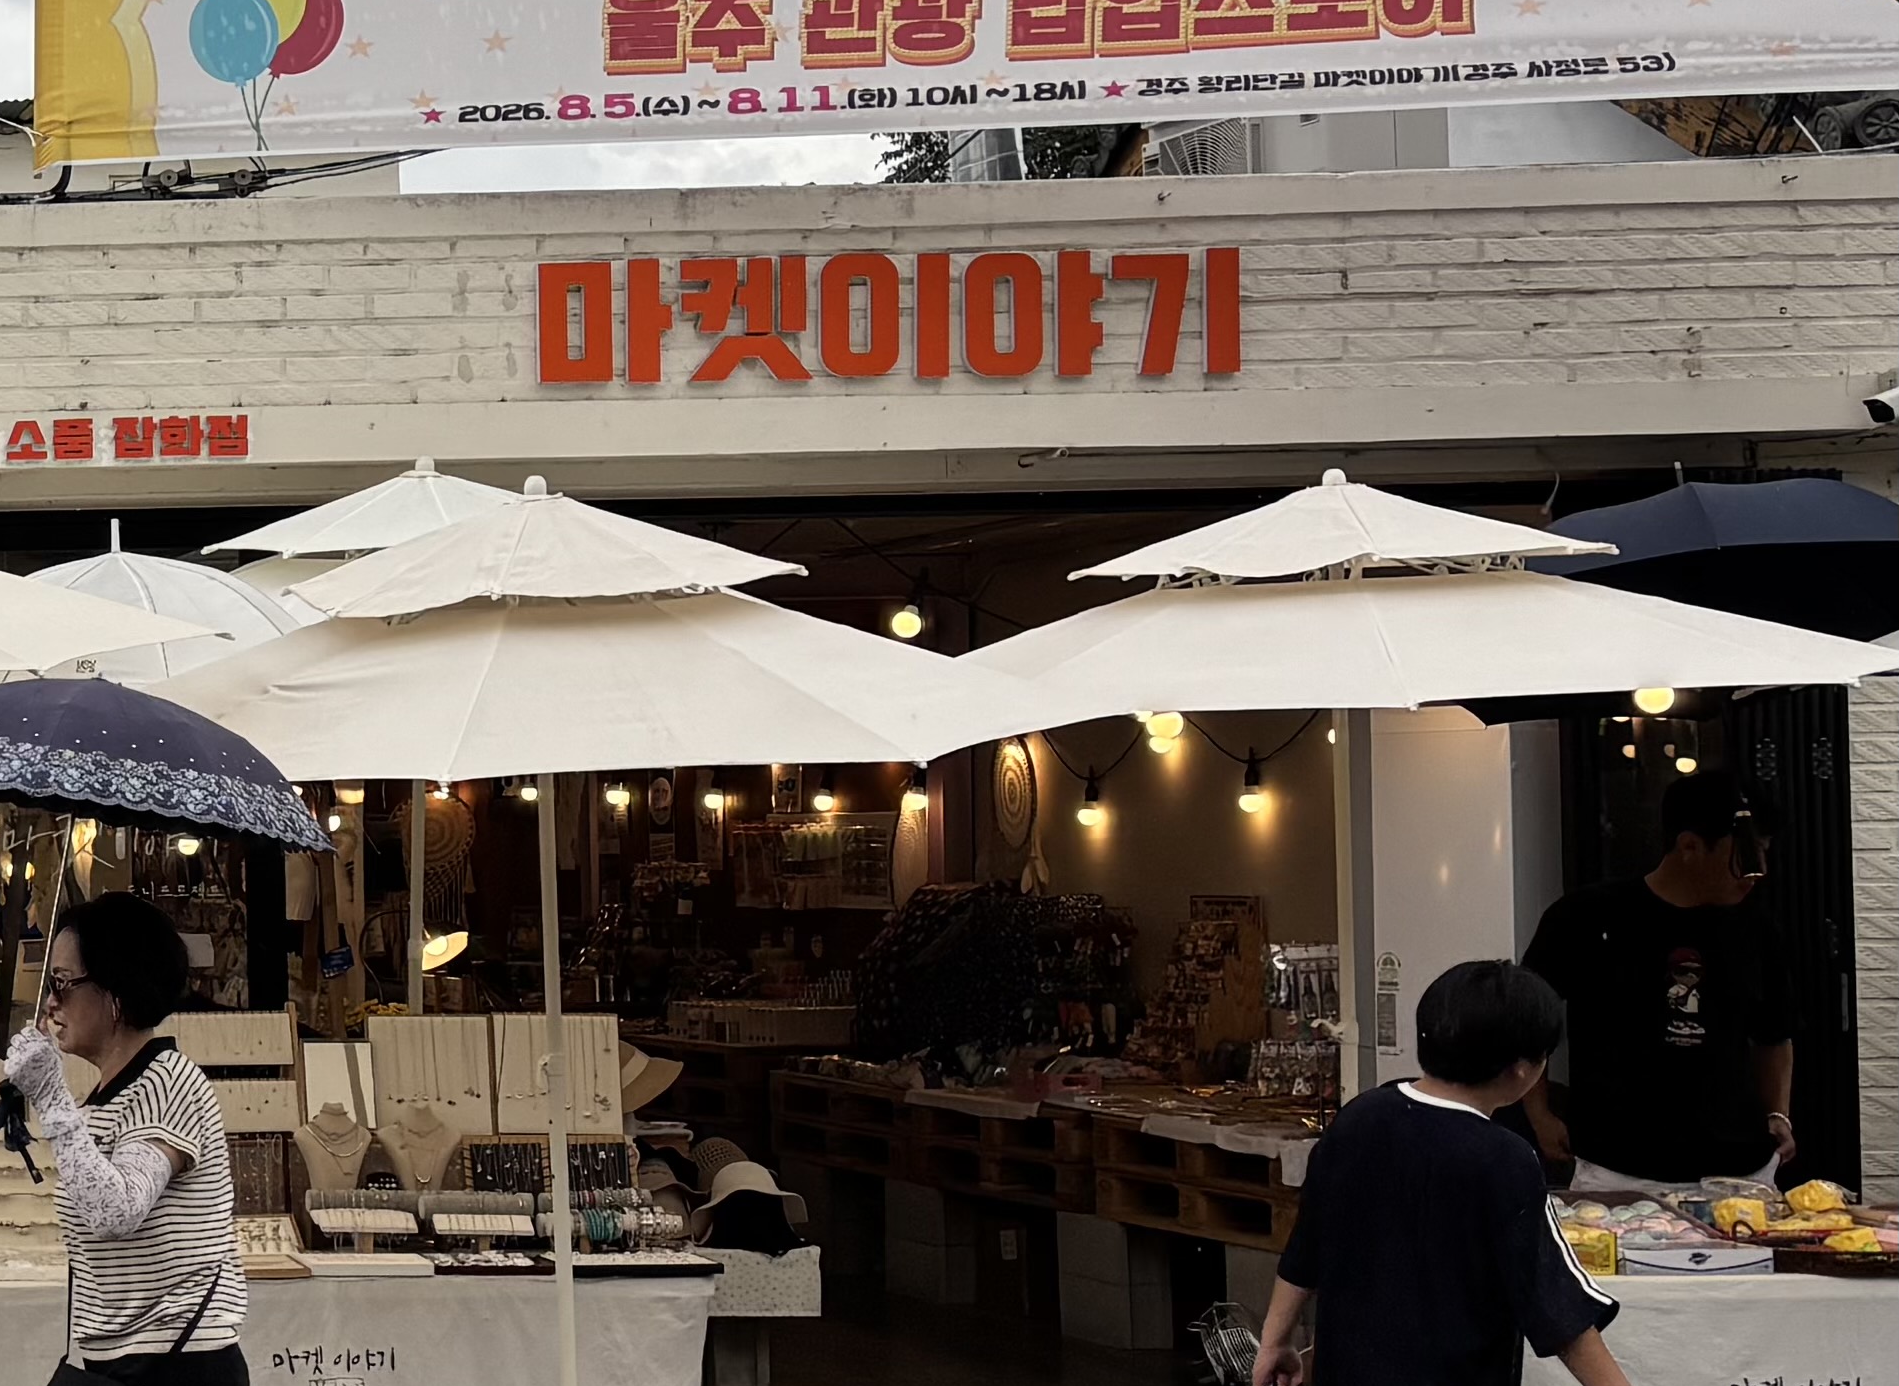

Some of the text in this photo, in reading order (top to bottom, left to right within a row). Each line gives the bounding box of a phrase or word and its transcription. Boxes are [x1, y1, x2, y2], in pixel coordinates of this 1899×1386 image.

[905, 84, 977, 107] 10시
[1136, 77, 1190, 97] 경주
[1197, 71, 1305, 94] 황리단길
[1526, 57, 1609, 78] 사정로
[536, 246, 1241, 385] 마켓이야기
[6, 418, 94, 461] 소품
[112, 414, 249, 459] 잡화점
[272, 1345, 395, 1375] 마켓 이야기
